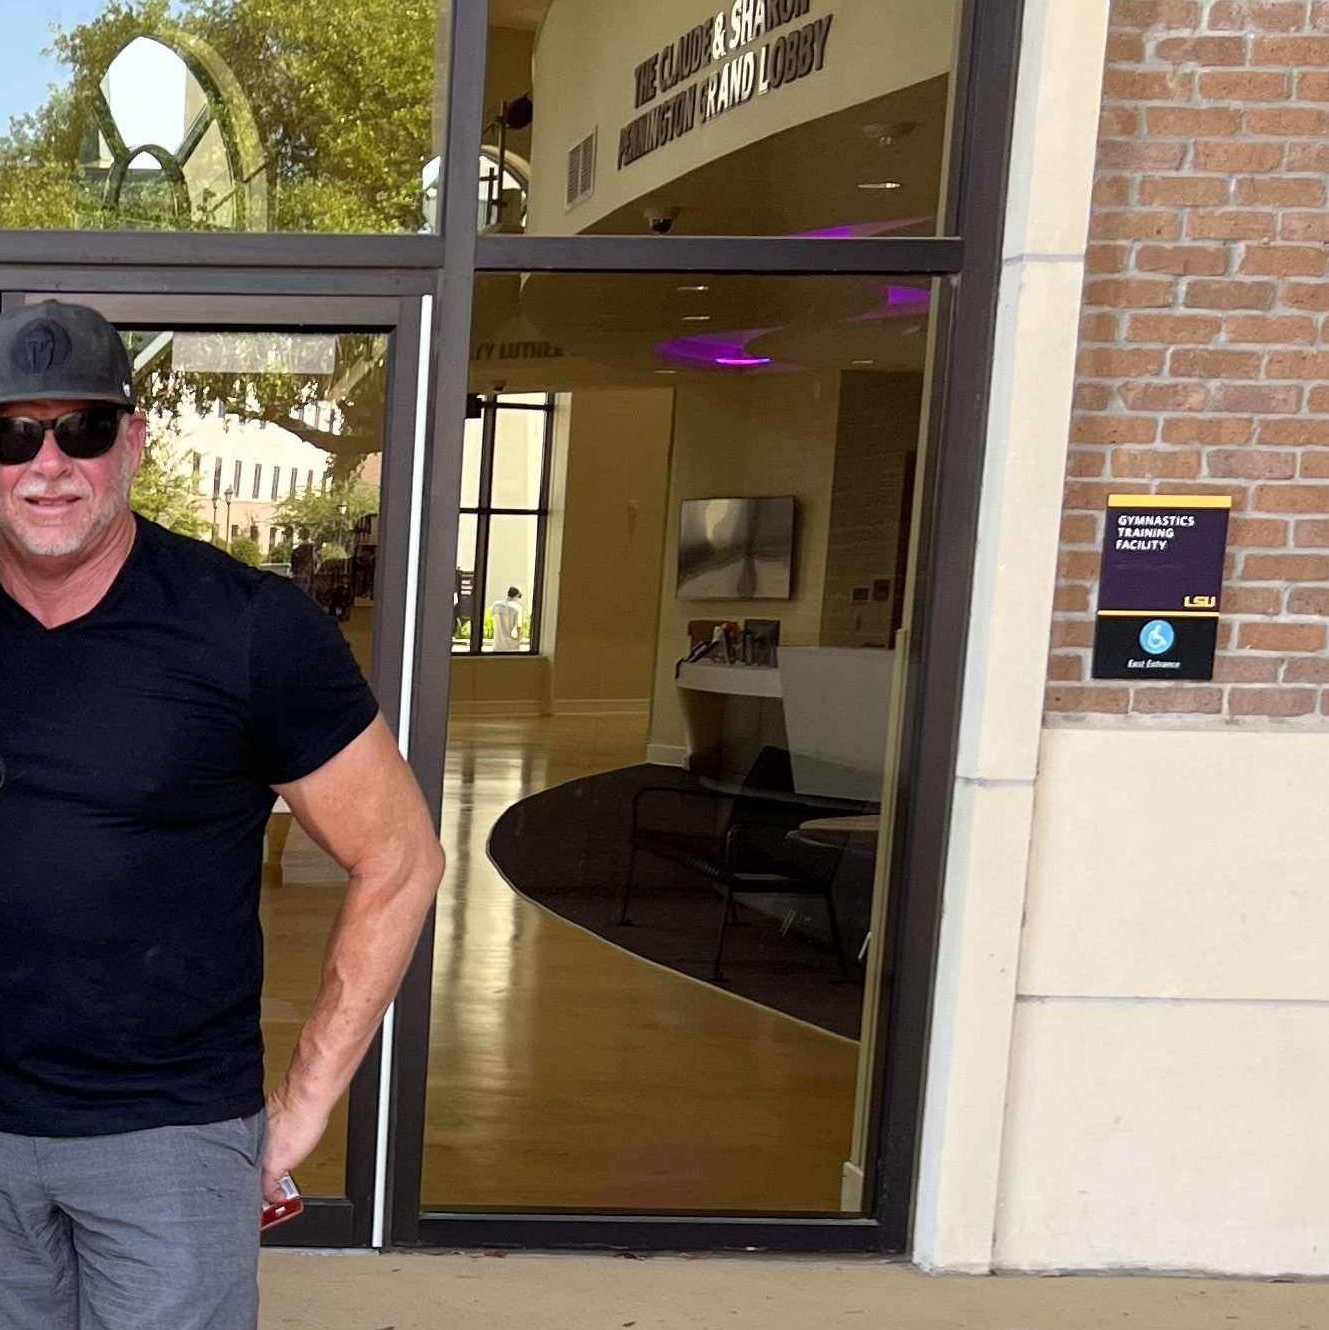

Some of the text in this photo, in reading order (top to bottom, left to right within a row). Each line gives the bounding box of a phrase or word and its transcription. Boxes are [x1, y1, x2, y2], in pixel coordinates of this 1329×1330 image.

[635, 53, 659, 109] THE
[659, 16, 714, 93] CLAUDE
[712, 11, 727, 60] &
[617, 14, 834, 171] PENNINGTON GRAND LOBBY
[1117, 515, 1195, 527] GYMNASTICS
[1117, 528, 1175, 539] TRAINING
[1115, 539, 1167, 550] FACILITY
[1183, 596, 1216, 608] LSU
[1127, 659, 1180, 669] East Entrance
